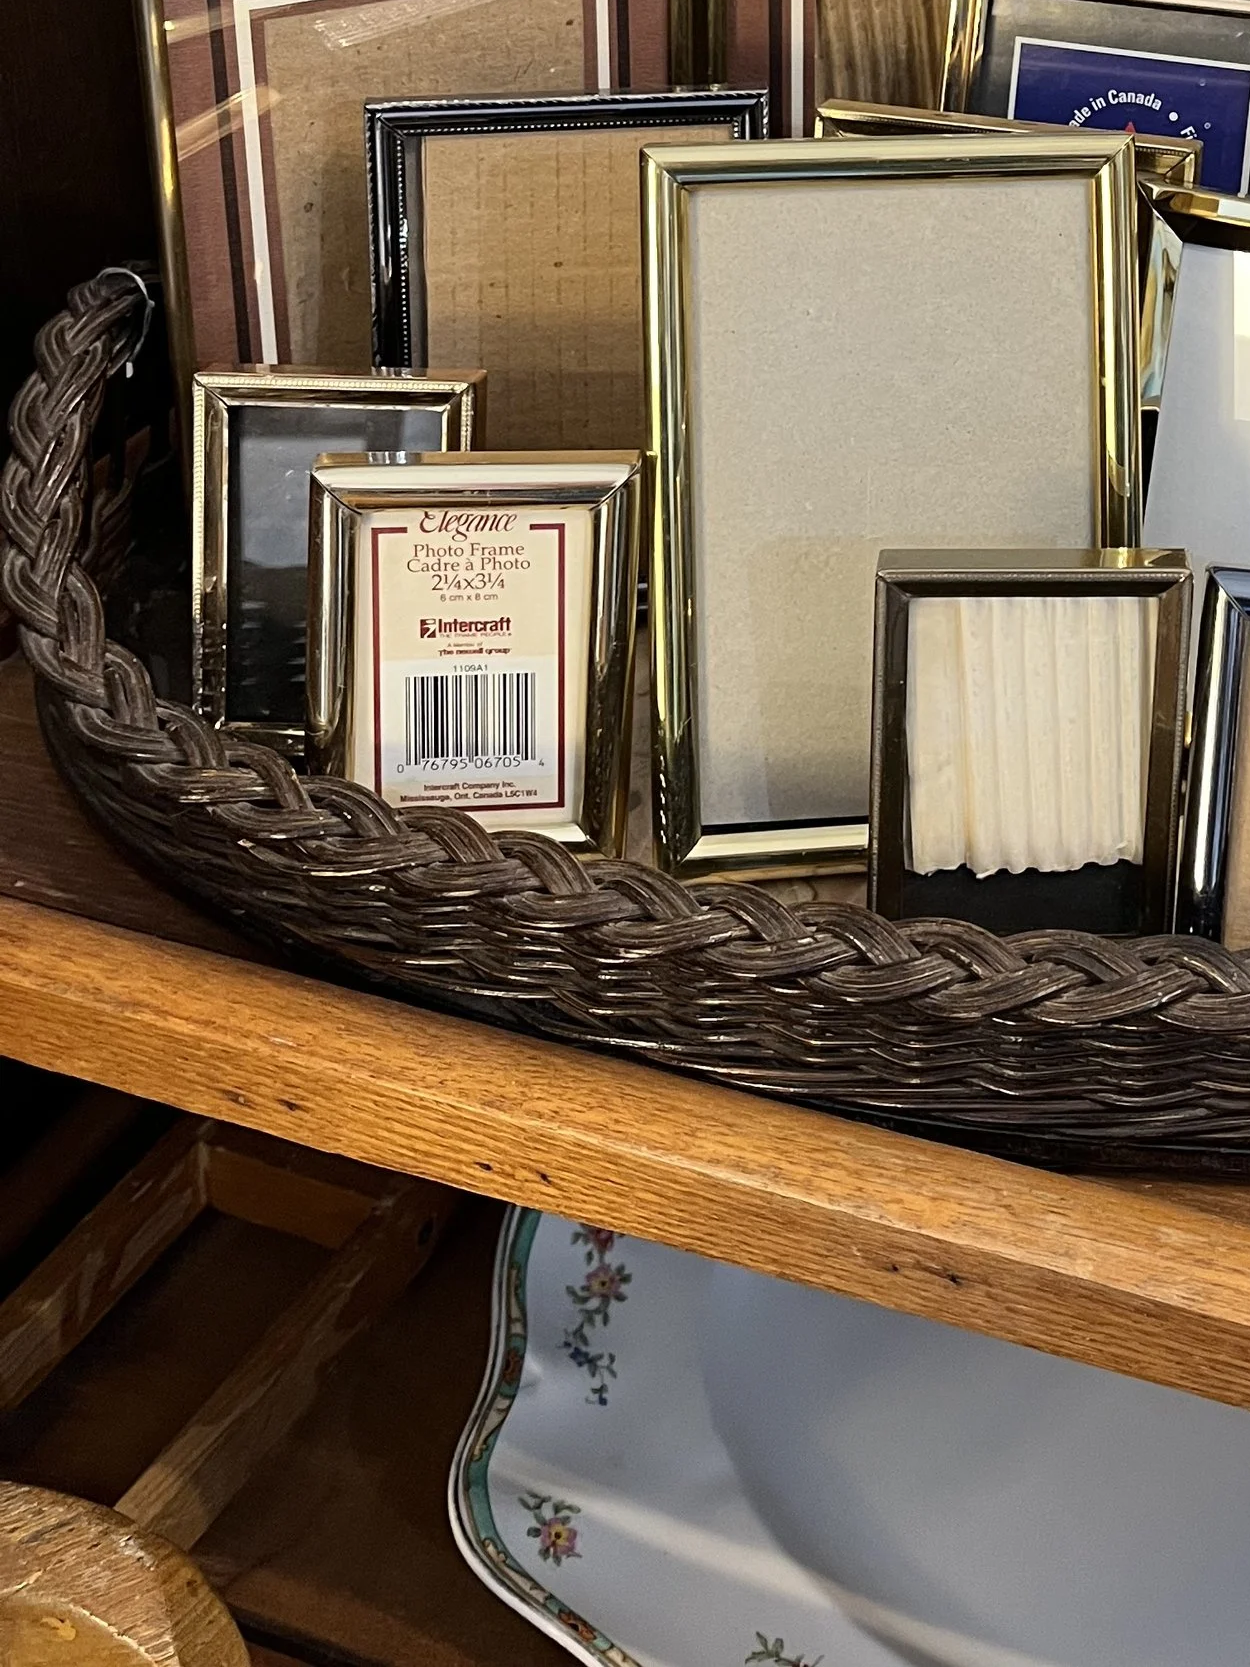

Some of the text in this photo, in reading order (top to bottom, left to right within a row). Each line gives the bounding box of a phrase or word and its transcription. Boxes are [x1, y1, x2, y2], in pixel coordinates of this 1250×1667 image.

[1069, 89, 1162, 126] ade in Canada
[419, 511, 517, 542] Elegance
[414, 543, 525, 557] Photo Frame
[407, 557, 531, 572] Cadre à Photo
[440, 594, 446, 602] 6
[438, 617, 511, 633] Intercraft
[397, 764, 404, 773] 0
[422, 758, 468, 771] 76795
[474, 756, 521, 769] 06705
[462, 781, 500, 790] Company
[473, 791, 503, 799] Canada
